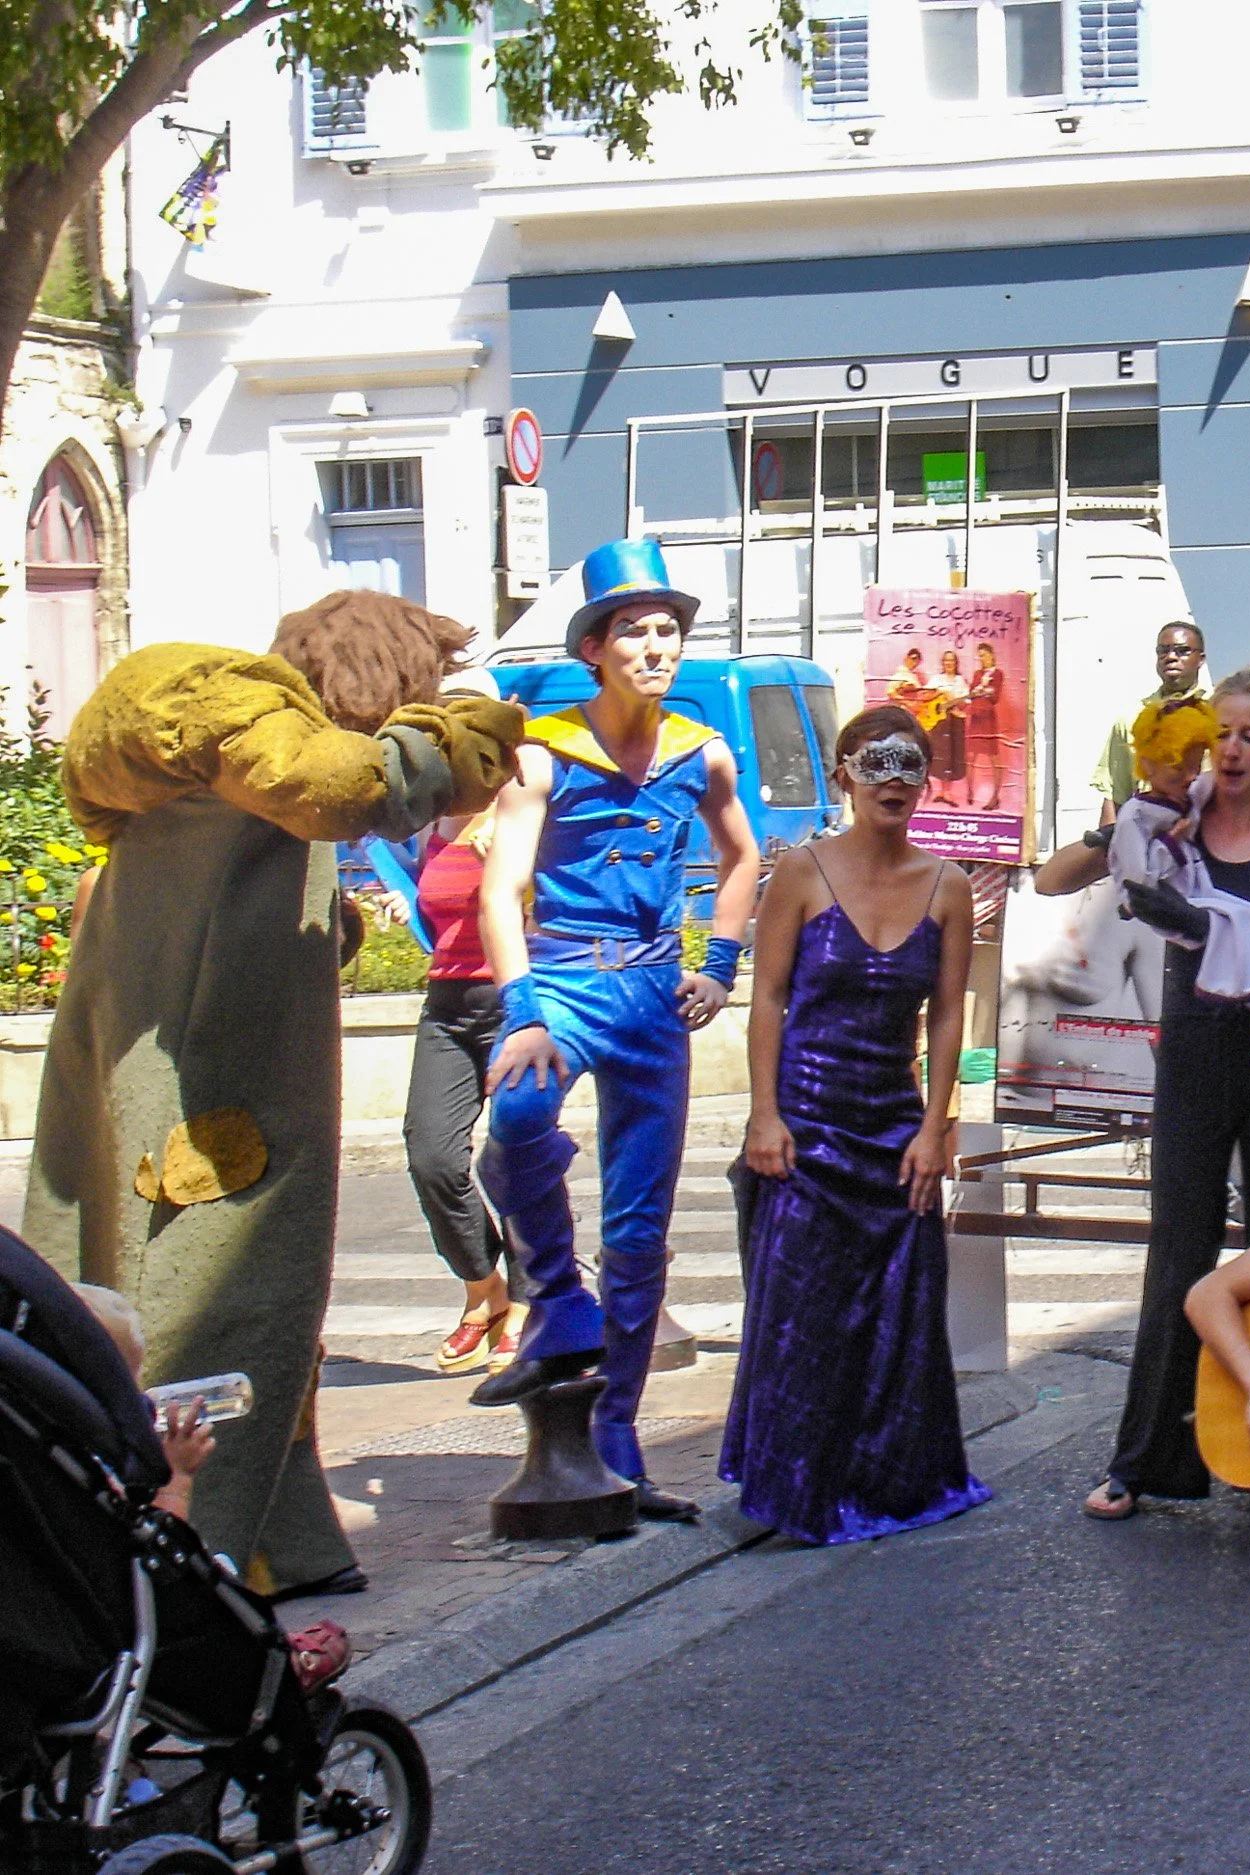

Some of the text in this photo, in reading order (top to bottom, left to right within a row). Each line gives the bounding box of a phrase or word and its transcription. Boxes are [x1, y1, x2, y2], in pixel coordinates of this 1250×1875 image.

[749, 350, 1135, 396] VOGUE
[877, 598, 915, 618] Les
[891, 622, 916, 635] se
